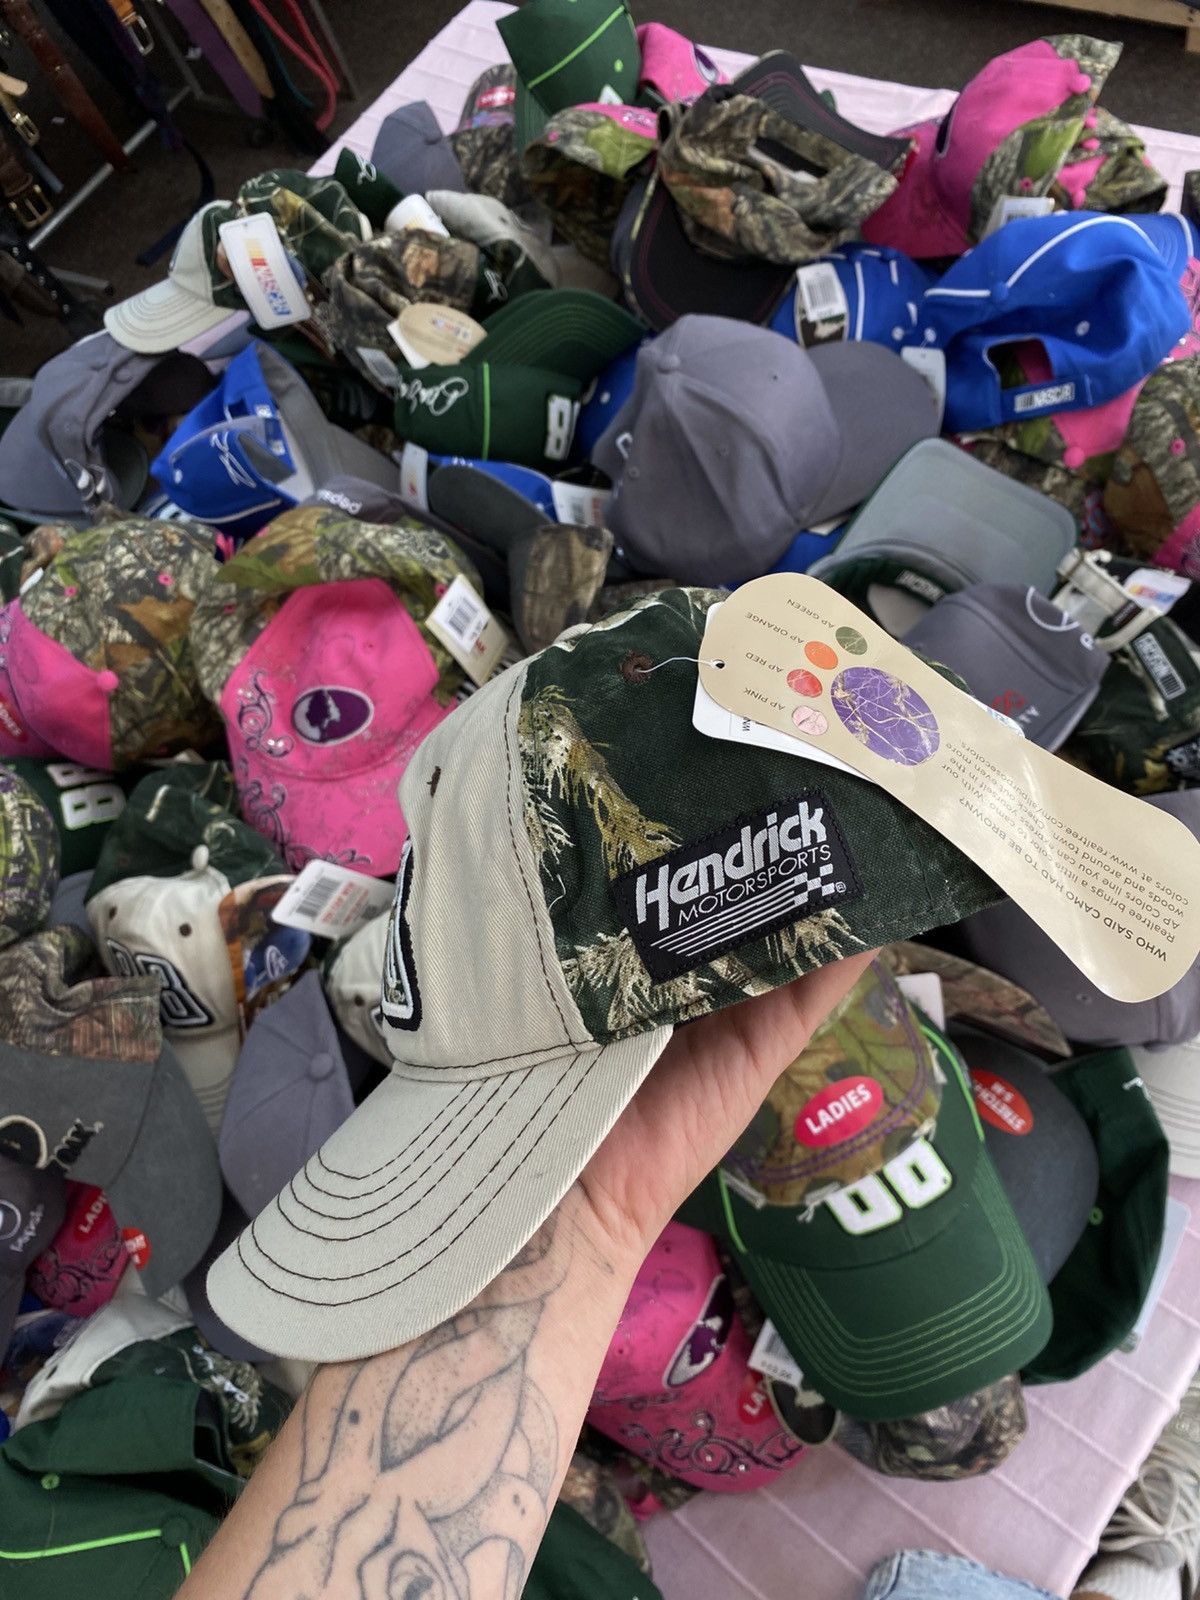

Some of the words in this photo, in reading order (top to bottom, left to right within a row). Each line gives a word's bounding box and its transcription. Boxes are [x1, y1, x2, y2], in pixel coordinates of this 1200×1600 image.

[786, 598, 820, 620] GREEN
[745, 611, 788, 636] ORANGE
[820, 618, 834, 628] AP
[789, 633, 803, 644] AP
[745, 650, 766, 665] RED
[768, 662, 783, 673] AP
[743, 686, 768, 703] PINK
[768, 699, 785, 711] AP
[944, 741, 972, 765] more
[940, 762, 960, 779] our
[948, 756, 967, 773] the
[972, 763, 998, 785] even
[966, 771, 978, 783] in
[959, 777, 987, 802] With
[998, 784, 1016, 802] out
[957, 795, 1007, 839] BROWN?
[1015, 800, 1045, 830] Check
[1006, 837, 1022, 854] BE
[1028, 838, 1052, 862] color
[635, 801, 826, 931] Hendrick
[1022, 853, 1040, 870] TO
[1054, 849, 1076, 866] can
[1080, 850, 1122, 880] around
[1039, 868, 1064, 891] HAD
[1052, 859, 1080, 883] little
[1077, 861, 1100, 880] you
[1139, 872, 1152, 884] at
[678, 844, 832, 927] MOTORSPORTS
[1079, 878, 1088, 887] a
[1100, 877, 1122, 895] line
[1122, 876, 1145, 894] and
[1153, 880, 1189, 907] colors
[1063, 889, 1101, 919] CAMO
[1089, 883, 1127, 912] brings
[1122, 890, 1161, 918] Colors
[1145, 890, 1184, 918] woods
[1101, 915, 1134, 940] SAID
[1126, 908, 1176, 943] Realtree
[1161, 915, 1180, 930] AP
[1134, 935, 1169, 961] WHO
[804, 1083, 873, 1136] LADIES
